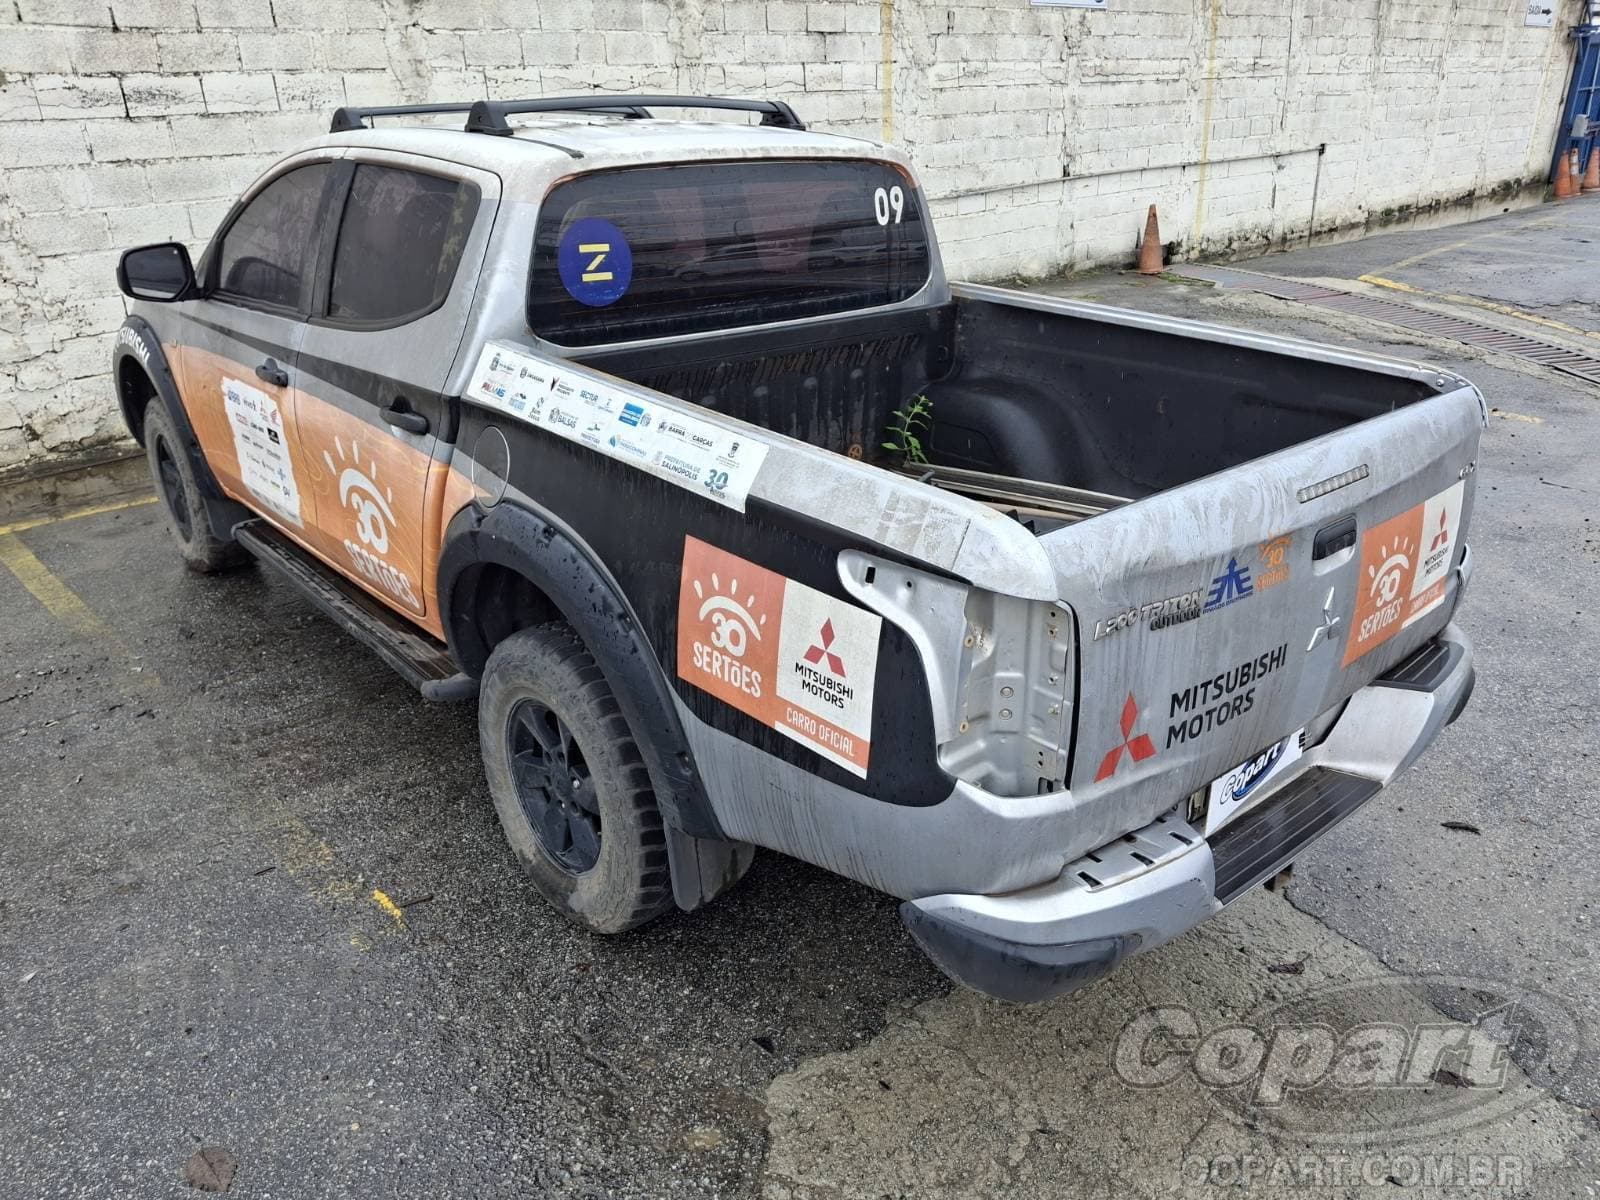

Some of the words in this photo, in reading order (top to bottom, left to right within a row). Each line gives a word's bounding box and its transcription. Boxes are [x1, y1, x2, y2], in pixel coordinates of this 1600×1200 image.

[874, 185, 905, 226] 09
[558, 415, 577, 429] BALSAS
[668, 426, 685, 437] BARRA
[704, 468, 729, 490] 30
[351, 492, 389, 554] 30
[1376, 568, 1401, 607] 30
[711, 611, 747, 657] 30
[1093, 607, 1138, 641] L200
[1140, 588, 1203, 622] TRITON
[1150, 606, 1201, 631] OUTDOOR
[693, 641, 762, 698] SERTÕES
[795, 662, 854, 701] MITSUBISHI
[1169, 643, 1288, 719] MITSUBISHI
[802, 680, 845, 709] MOTORS
[786, 707, 817, 736] CARRO
[819, 724, 855, 757] OFICIAL
[1166, 687, 1256, 749] MOTORS
[1220, 740, 1281, 805] Copart
